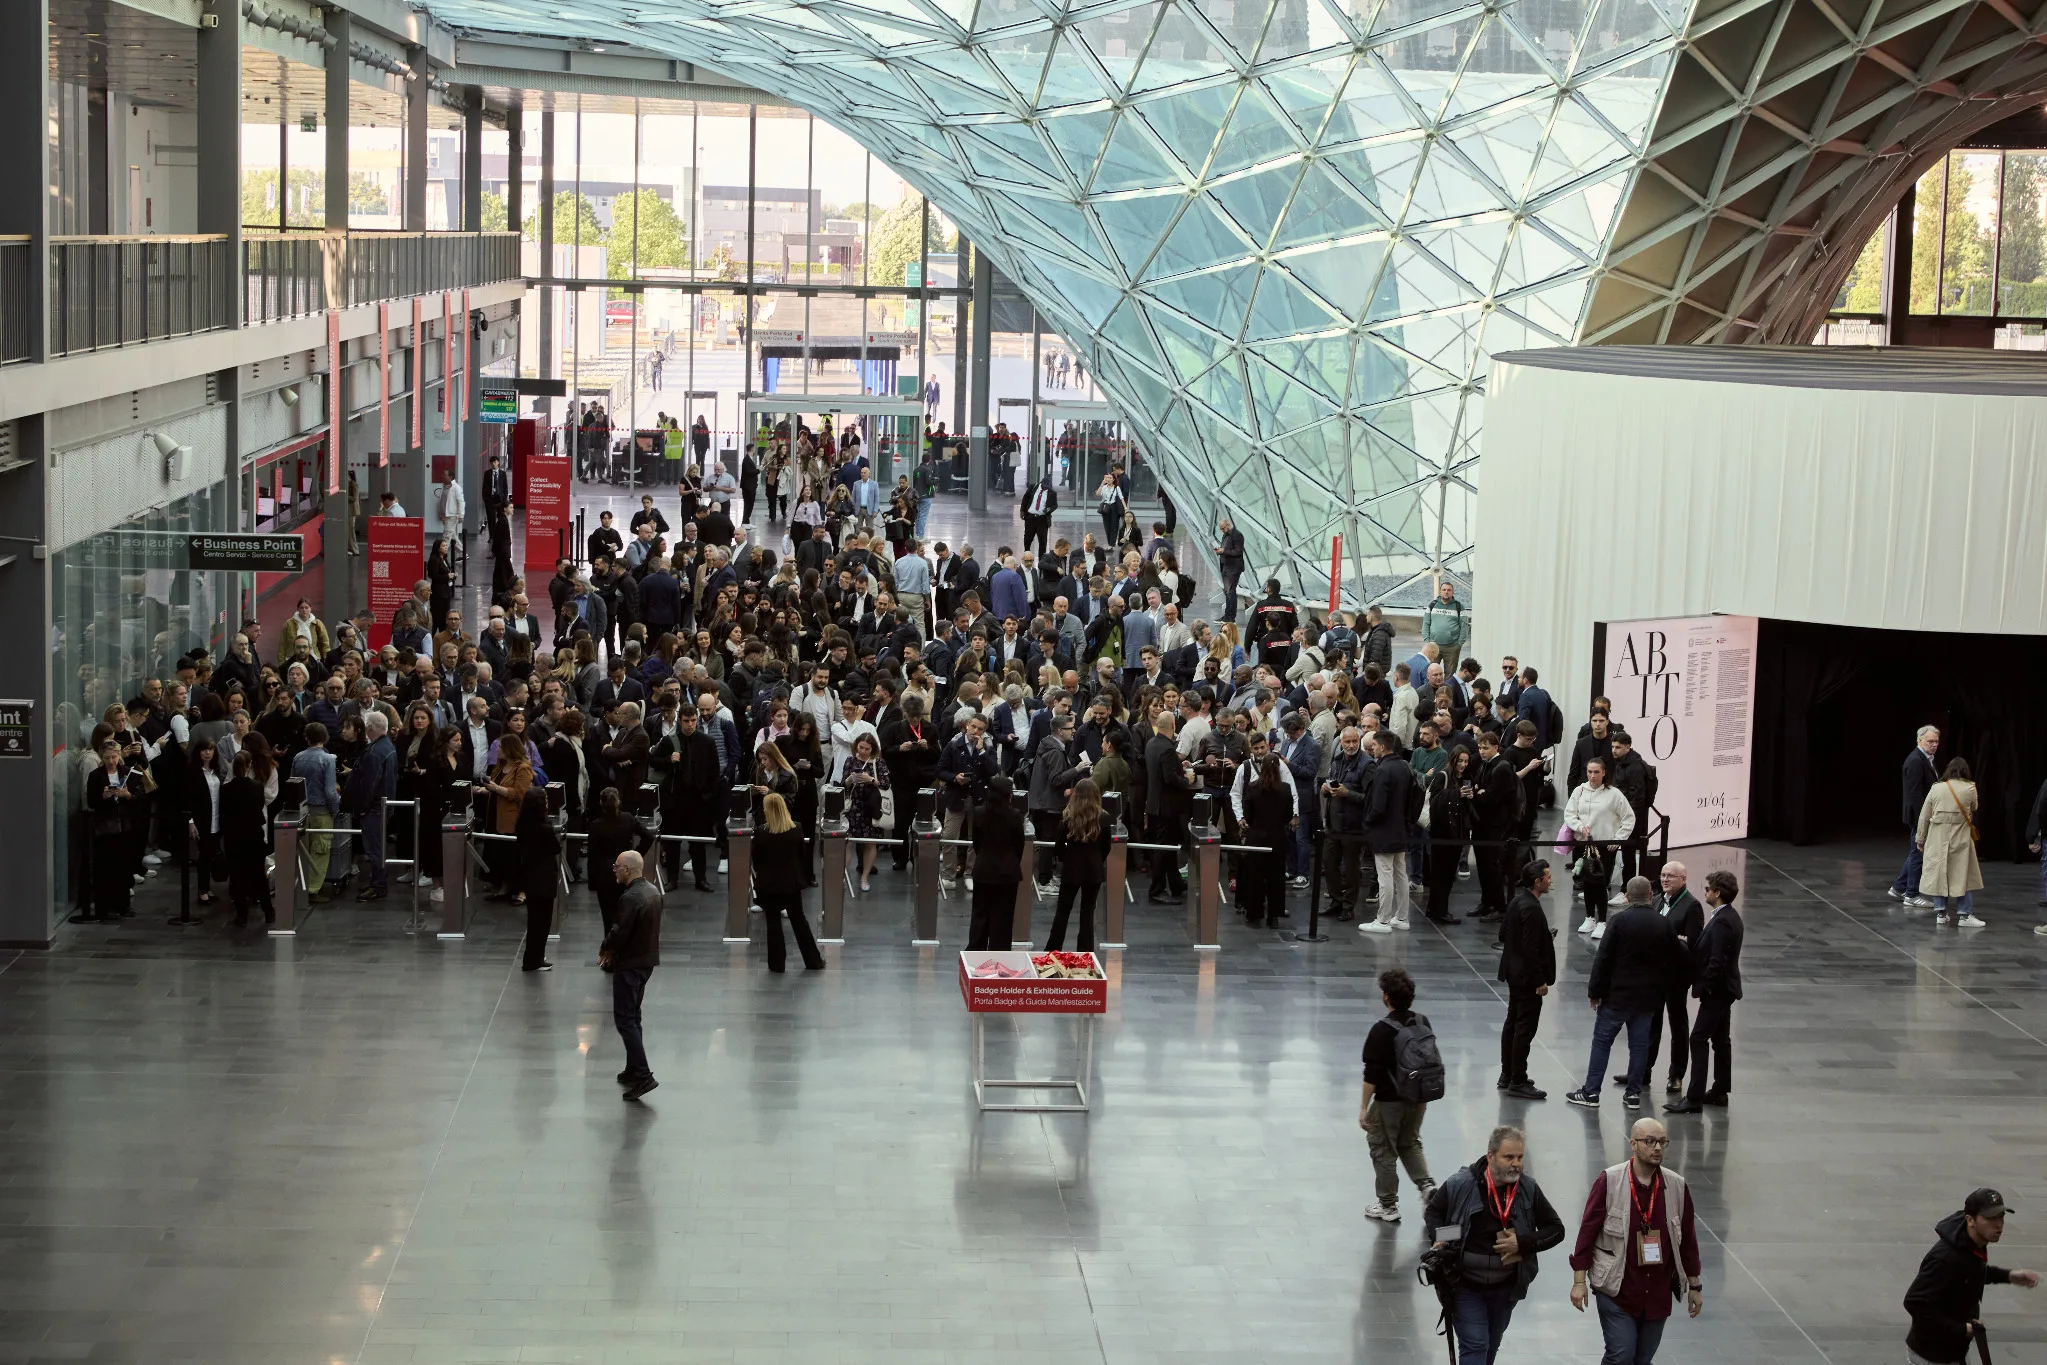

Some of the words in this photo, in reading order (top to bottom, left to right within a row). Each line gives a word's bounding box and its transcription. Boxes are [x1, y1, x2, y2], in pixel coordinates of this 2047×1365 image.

[203, 538, 260, 550] Business
[263, 539, 296, 551] Point
[203, 550, 225, 558] Centro
[252, 551, 275, 559] Service
[1612, 631, 1667, 678] AB
[1637, 672, 1680, 718] IT
[1651, 715, 1678, 760] O
[1696, 791, 1725, 809] 21/04
[1710, 812, 1741, 829] 26/04
[974, 986, 999, 995] Badge
[1000, 986, 1025, 994] Holder
[1026, 987, 1032, 995] &
[1033, 987, 1070, 995] Exhibition
[1071, 987, 1094, 995] Guide
[974, 997, 993, 1005] Porta
[994, 997, 1017, 1007] Badge
[1025, 998, 1047, 1006] Guida
[1047, 998, 1101, 1006] Manifestazione
